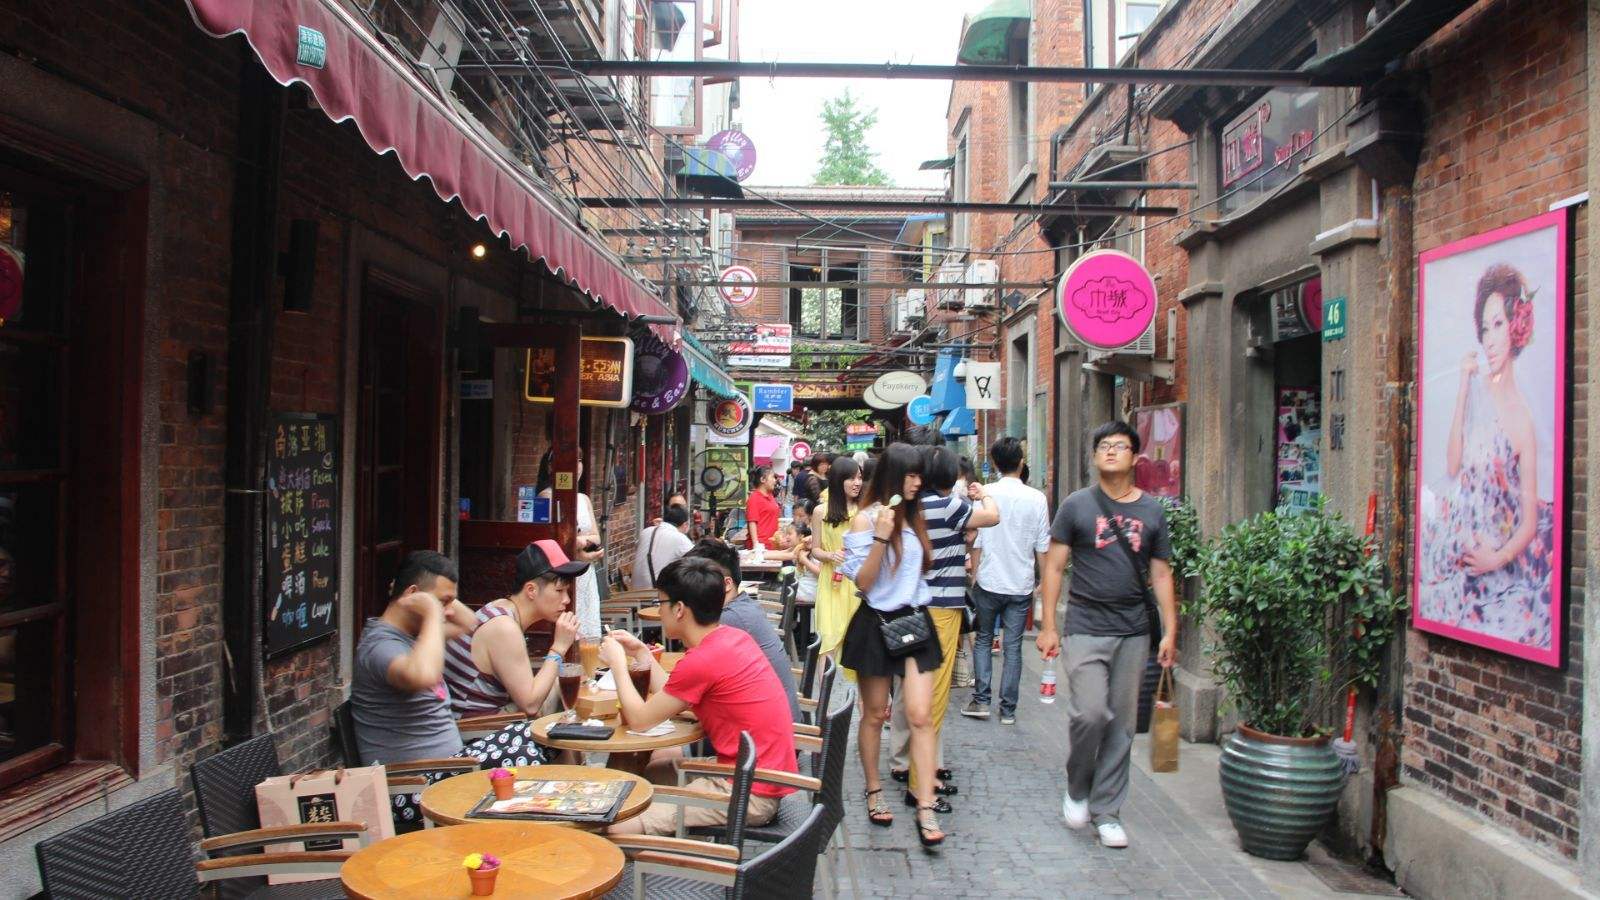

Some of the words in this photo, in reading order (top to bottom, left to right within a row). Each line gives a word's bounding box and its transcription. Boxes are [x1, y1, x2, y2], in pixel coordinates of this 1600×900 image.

[1328, 302, 1340, 325] 46
[598, 373, 620, 382] ASIA
[758, 387, 788, 396] Rambler
[281, 516, 308, 540] 小吃
[282, 571, 306, 598] 啤酒
